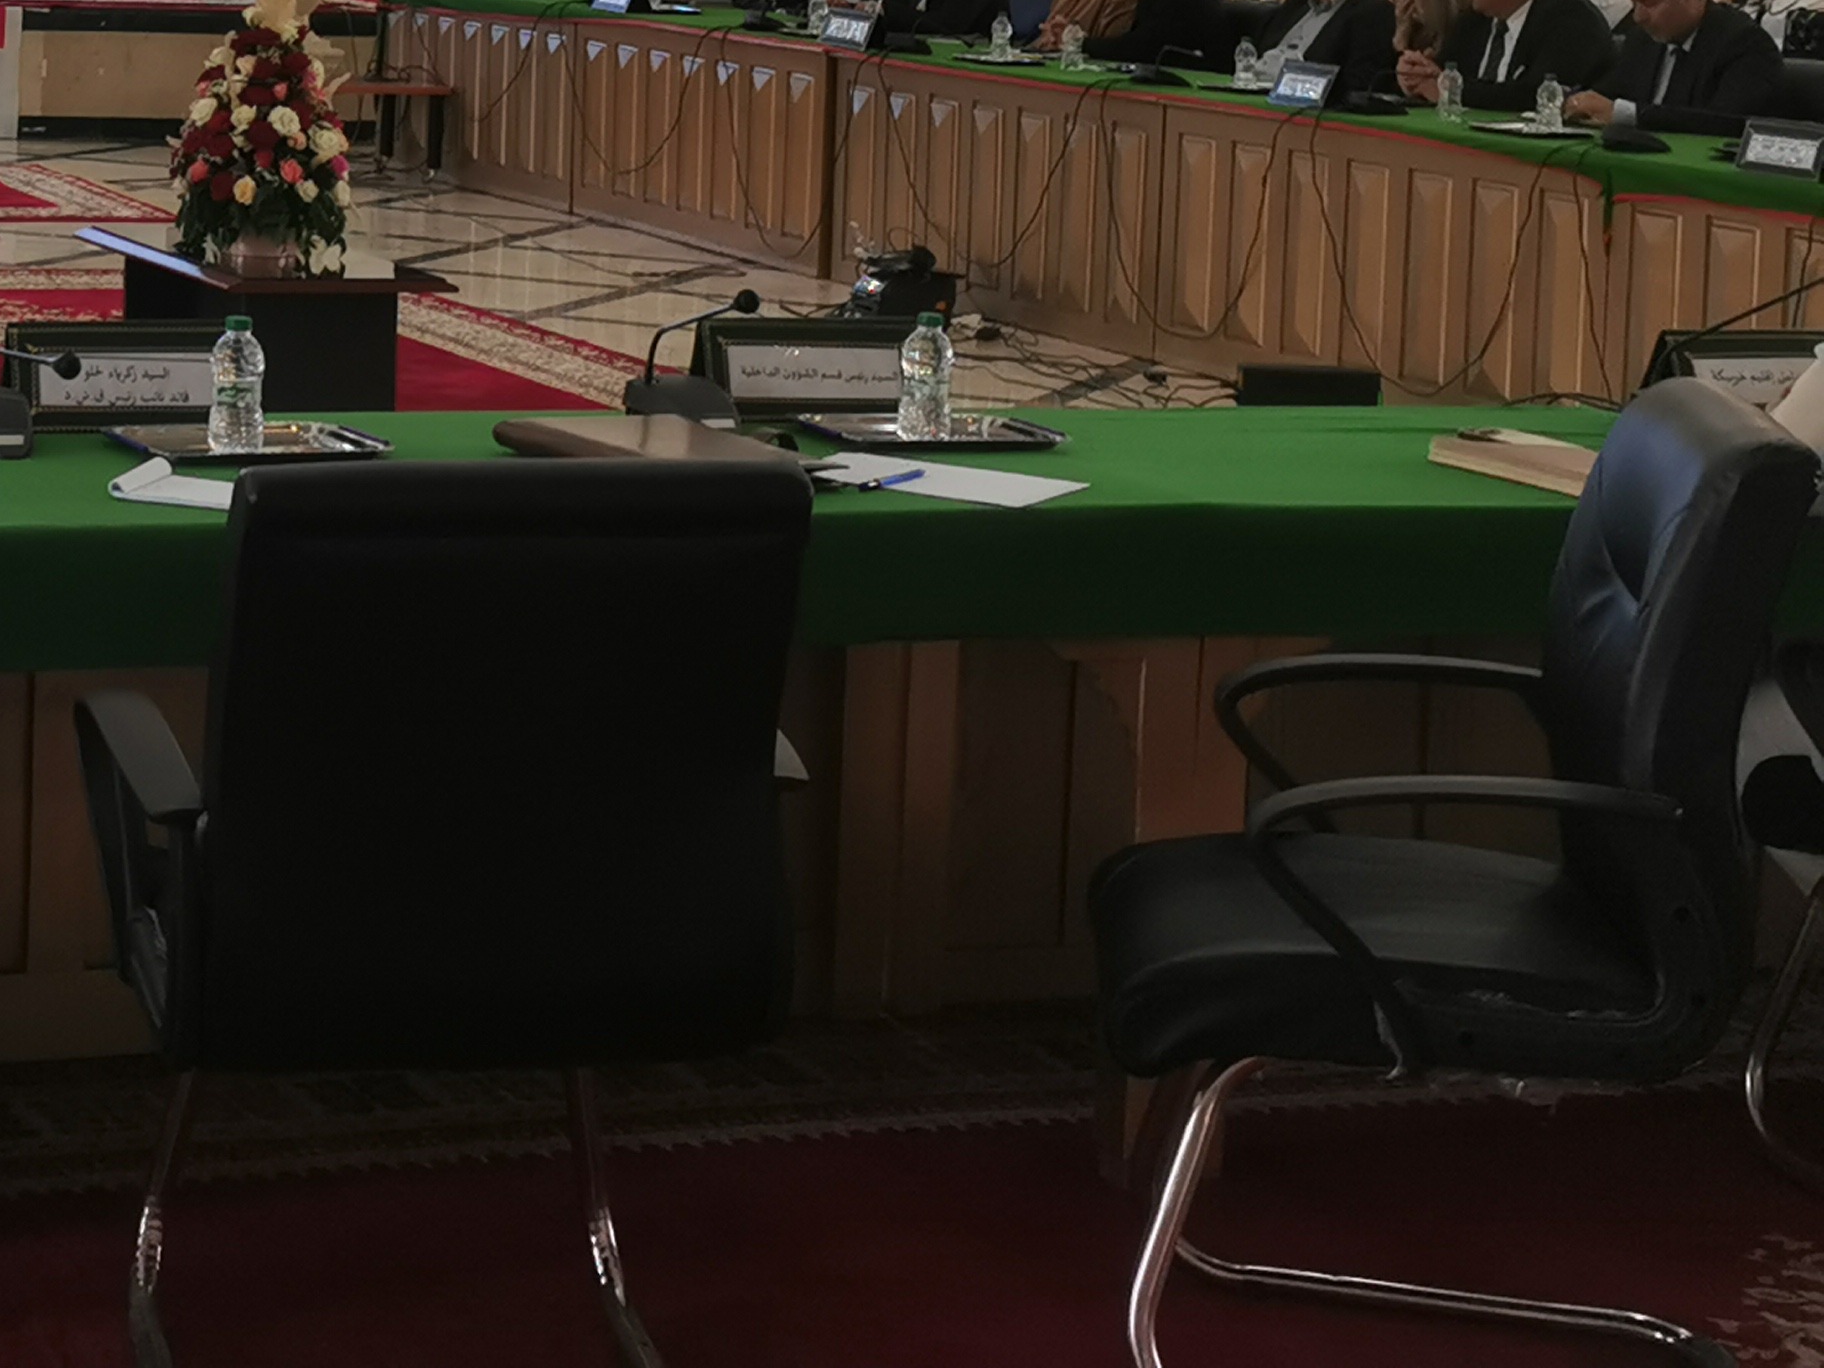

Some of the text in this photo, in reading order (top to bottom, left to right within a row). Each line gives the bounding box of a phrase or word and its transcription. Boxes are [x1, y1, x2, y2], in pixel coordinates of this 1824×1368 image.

[141, 366, 171, 382] السيد
[782, 367, 819, 381] الشؤون
[820, 369, 843, 382] قسم
